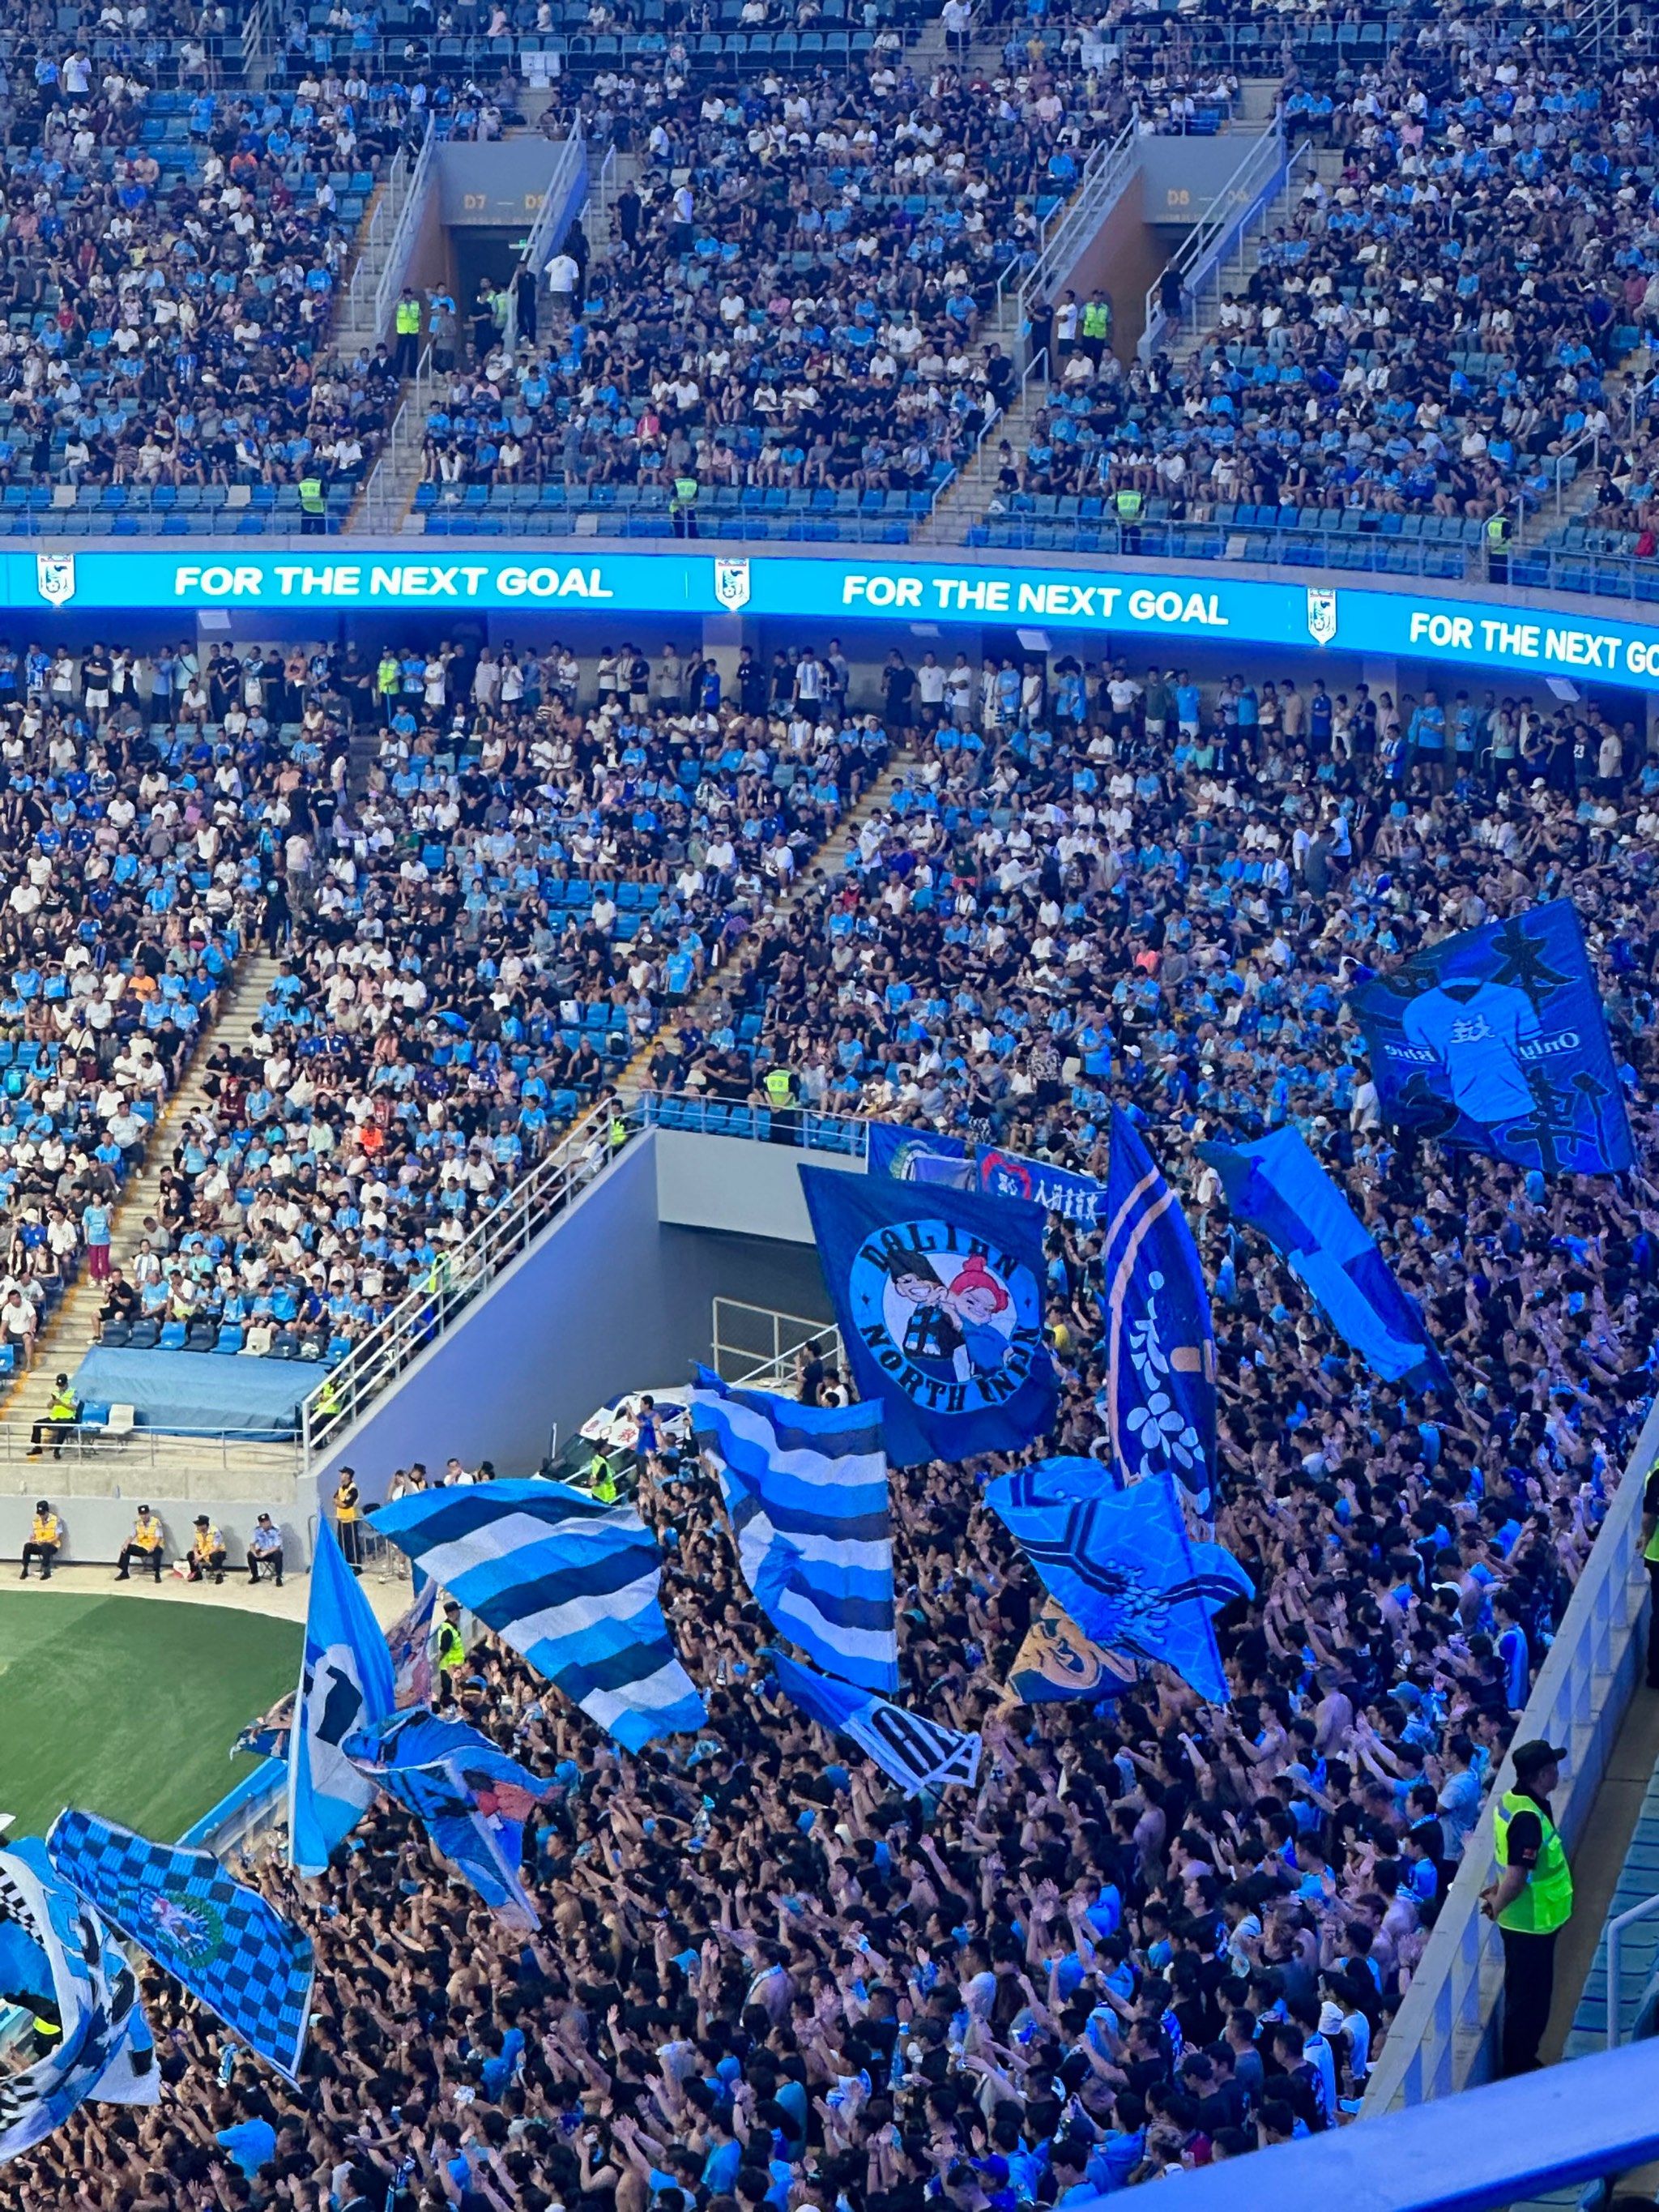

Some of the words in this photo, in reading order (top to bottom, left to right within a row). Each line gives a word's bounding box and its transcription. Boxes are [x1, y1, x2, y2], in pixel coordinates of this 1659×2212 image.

[463, 194, 486, 210] D7
[175, 566, 263, 596] FOR
[274, 566, 360, 596] THE
[370, 566, 488, 596] NEXT
[497, 567, 613, 597] GOAL
[842, 575, 923, 607] FOR
[932, 579, 1010, 611] THE
[1018, 583, 1122, 617] NEXT
[1128, 589, 1229, 626] GOAL
[1410, 612, 1473, 649] FOR
[1480, 620, 1541, 657] THE
[1545, 629, 1622, 668] NEXT
[859, 1324, 966, 1412] NORTH
